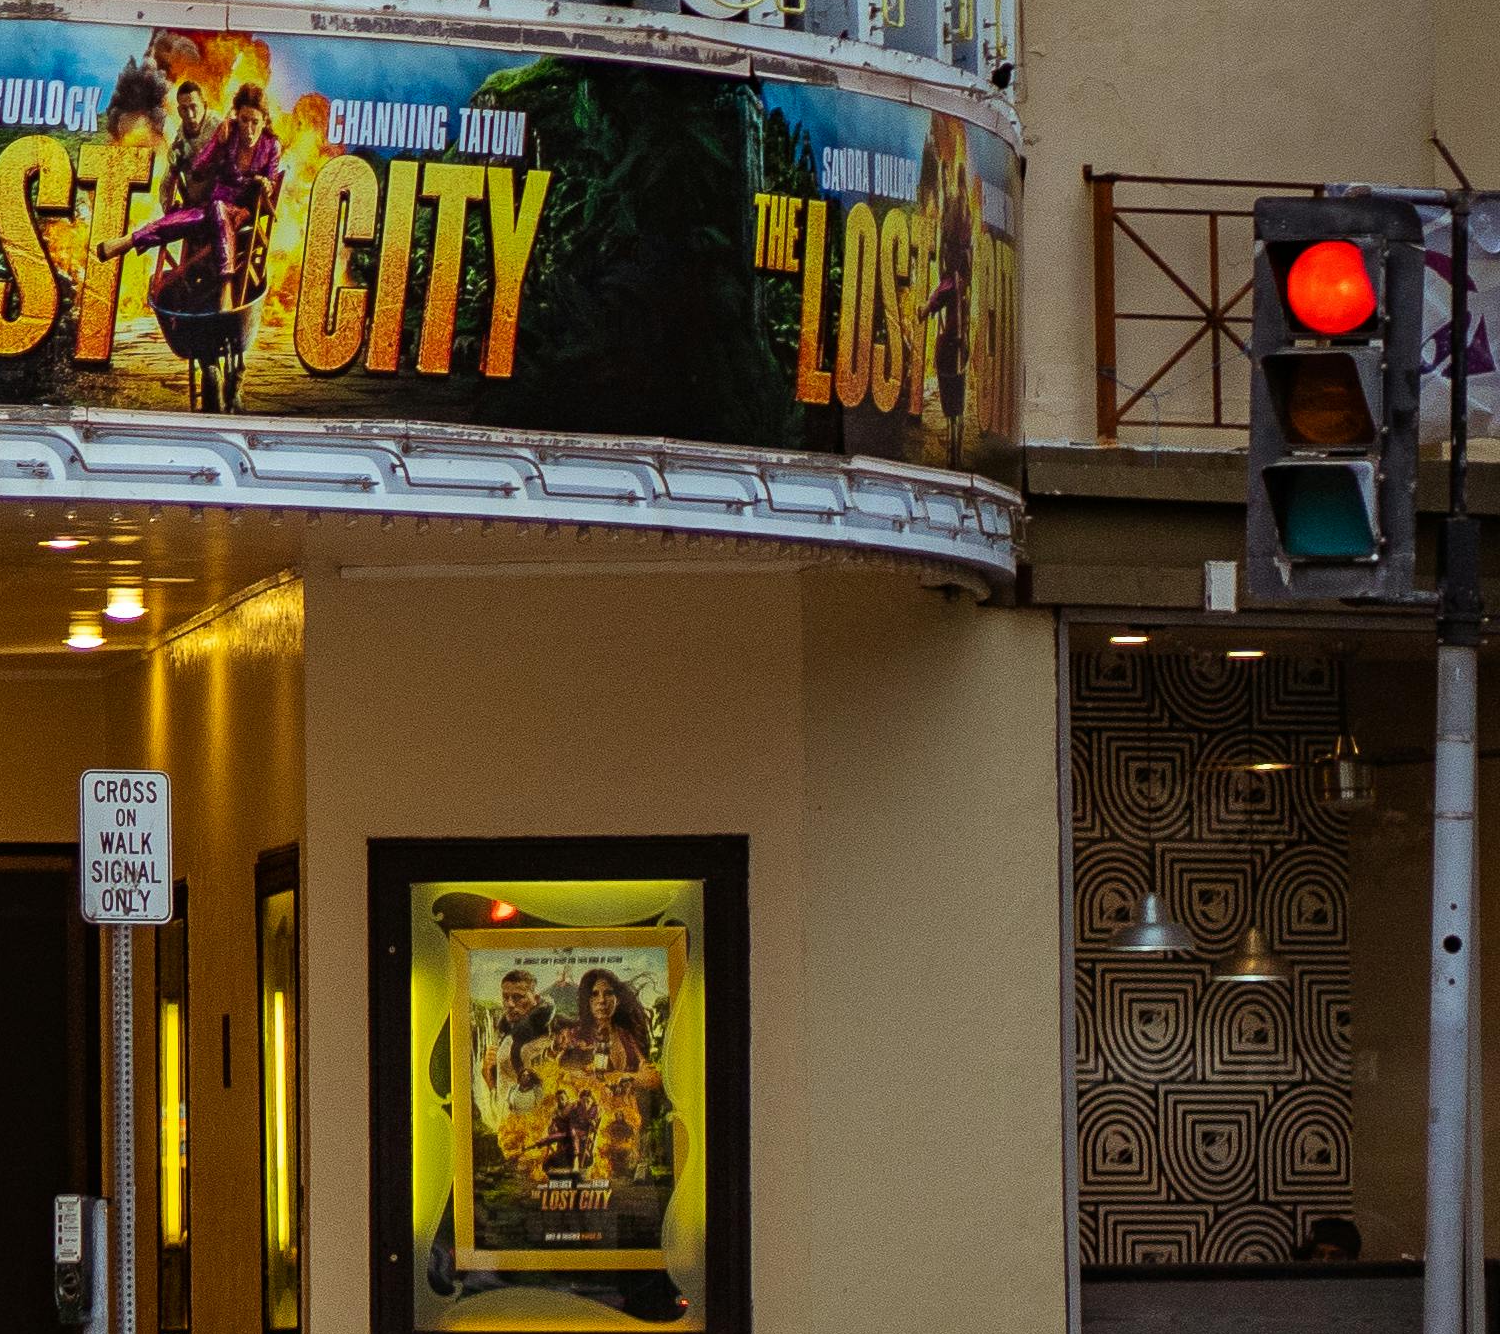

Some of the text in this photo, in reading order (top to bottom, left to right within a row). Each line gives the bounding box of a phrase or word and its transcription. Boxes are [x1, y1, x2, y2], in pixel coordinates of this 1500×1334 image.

[326, 97, 528, 158] CHANNING TATUM
[821, 146, 870, 194] SANDRA
[294, 153, 553, 378] CITY
[753, 192, 803, 272] THE
[794, 199, 938, 416] LOST
[94, 779, 157, 803] CROSS
[116, 808, 136, 827] ON
[100, 832, 152, 855] WALK
[91, 860, 161, 884] SIGNAL
[102, 889, 151, 913] ONLY
[541, 1189, 578, 1212] LOST
[578, 1189, 612, 1210] CITY
